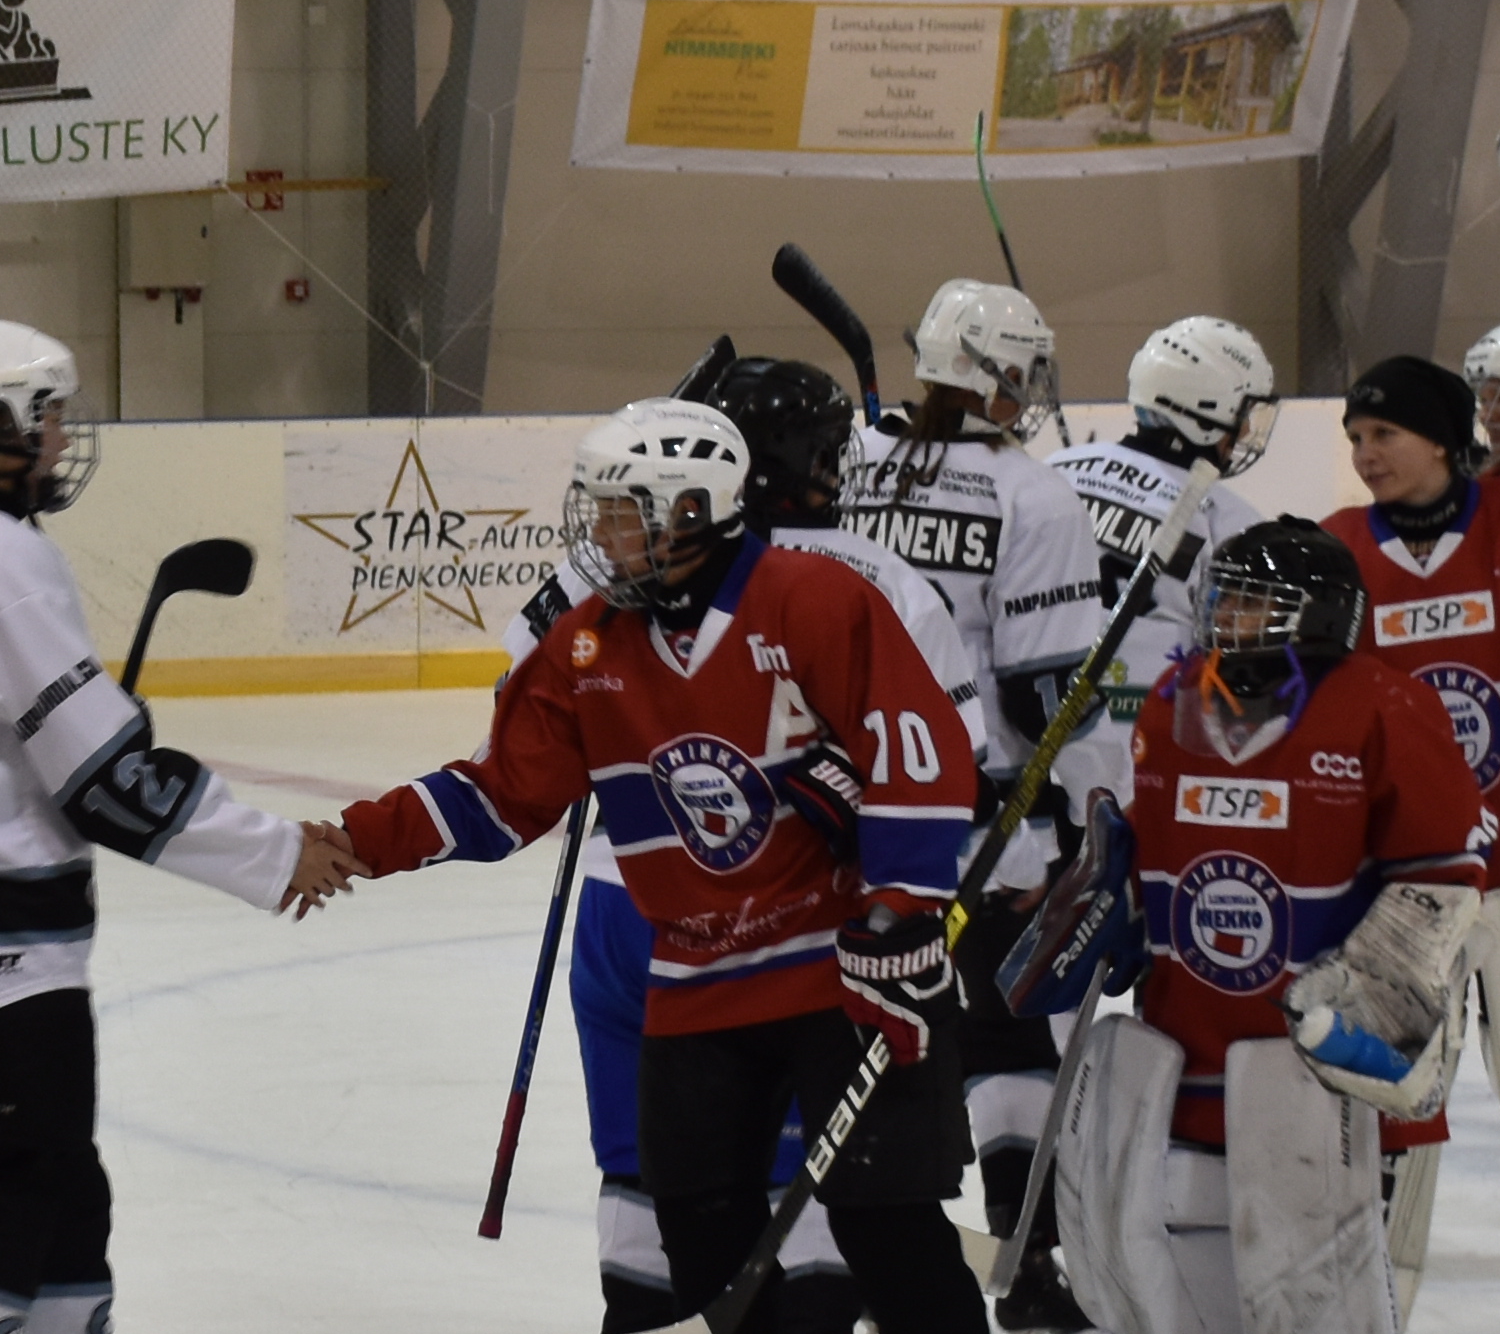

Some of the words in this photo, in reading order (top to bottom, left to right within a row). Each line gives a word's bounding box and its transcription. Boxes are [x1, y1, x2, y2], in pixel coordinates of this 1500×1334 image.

[160, 113, 222, 159] KY
[351, 506, 463, 552] STAR
[962, 522, 994, 569] S.
[351, 559, 549, 588] PIENKONEKOR
[1405, 601, 1464, 636] TSP
[862, 708, 942, 785] 10
[1204, 785, 1262, 819] TSP
[1051, 888, 1117, 979] Pallas
